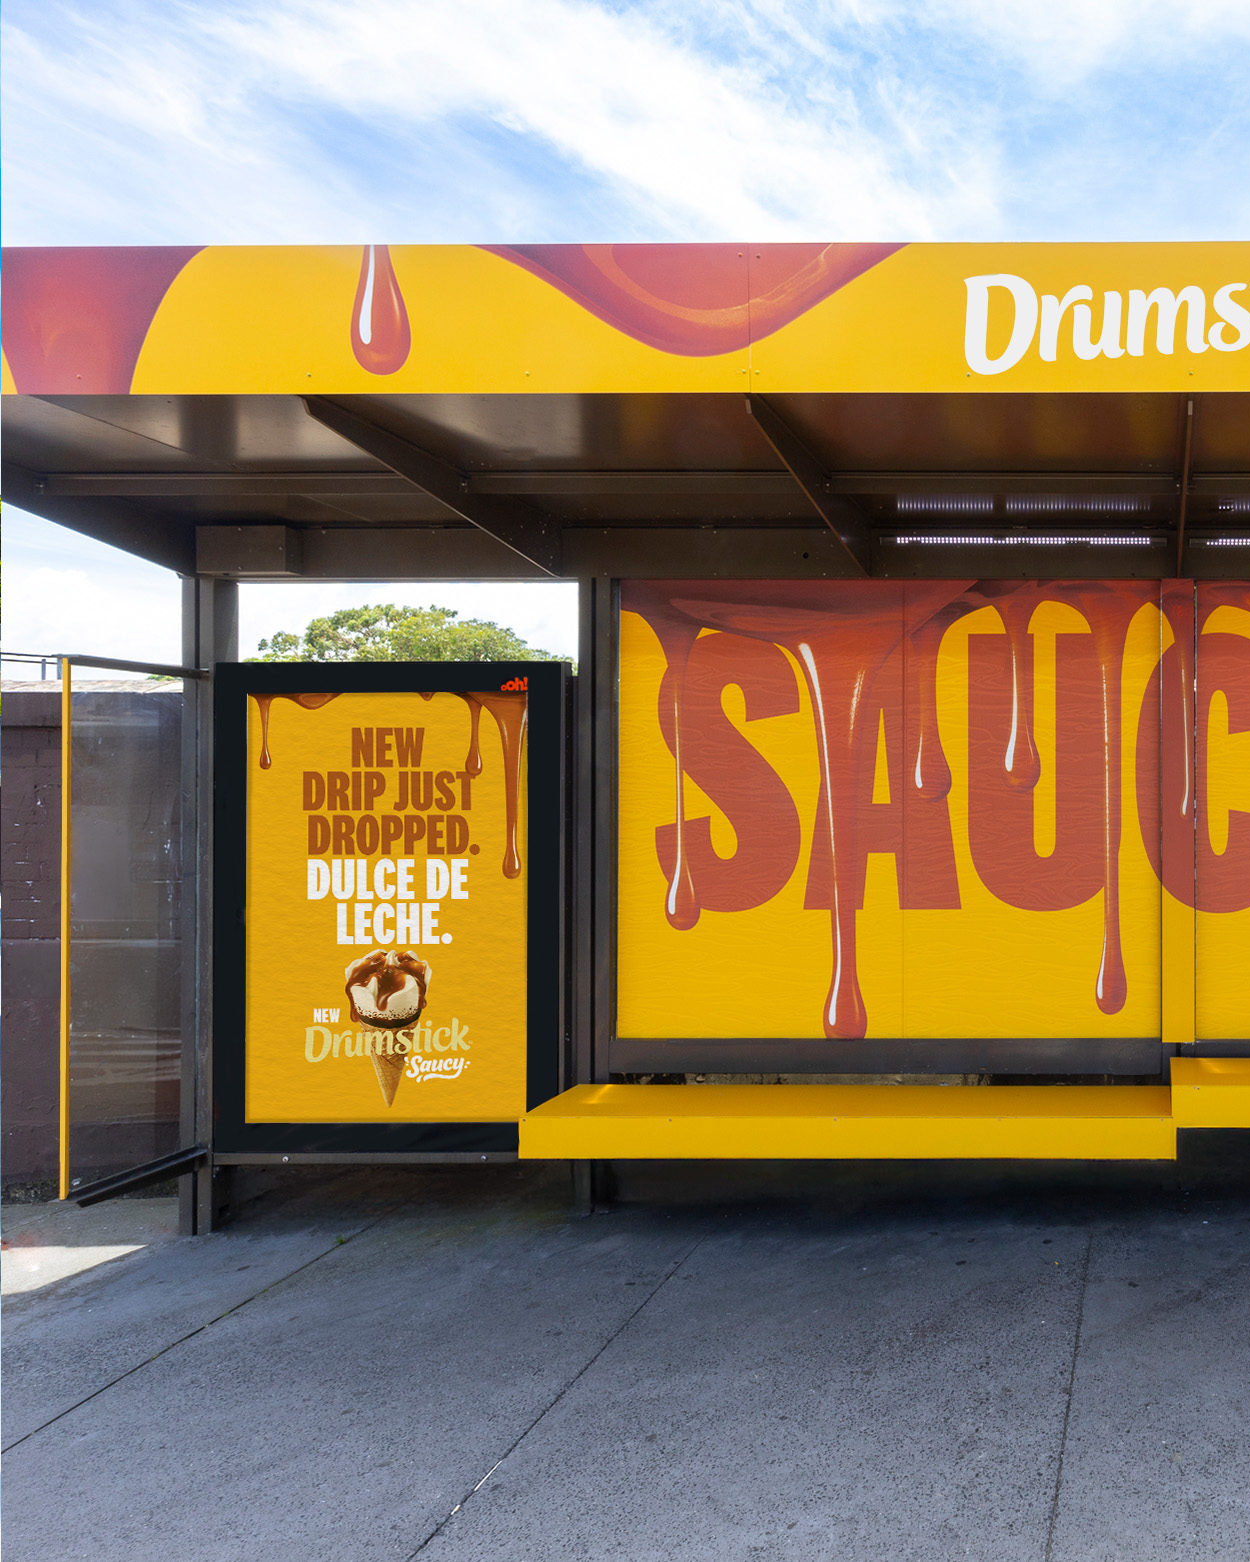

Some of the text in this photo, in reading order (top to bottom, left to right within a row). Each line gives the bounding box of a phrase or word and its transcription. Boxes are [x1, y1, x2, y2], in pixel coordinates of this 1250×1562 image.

[351, 728, 424, 767] NEW
[303, 771, 475, 811] DRIP JUST
[308, 815, 480, 855] DROPPED.
[307, 858, 469, 899] DULCE DE
[336, 903, 452, 944] LECHE.
[313, 1008, 340, 1023] NEW
[405, 1055, 465, 1083] Saucy
